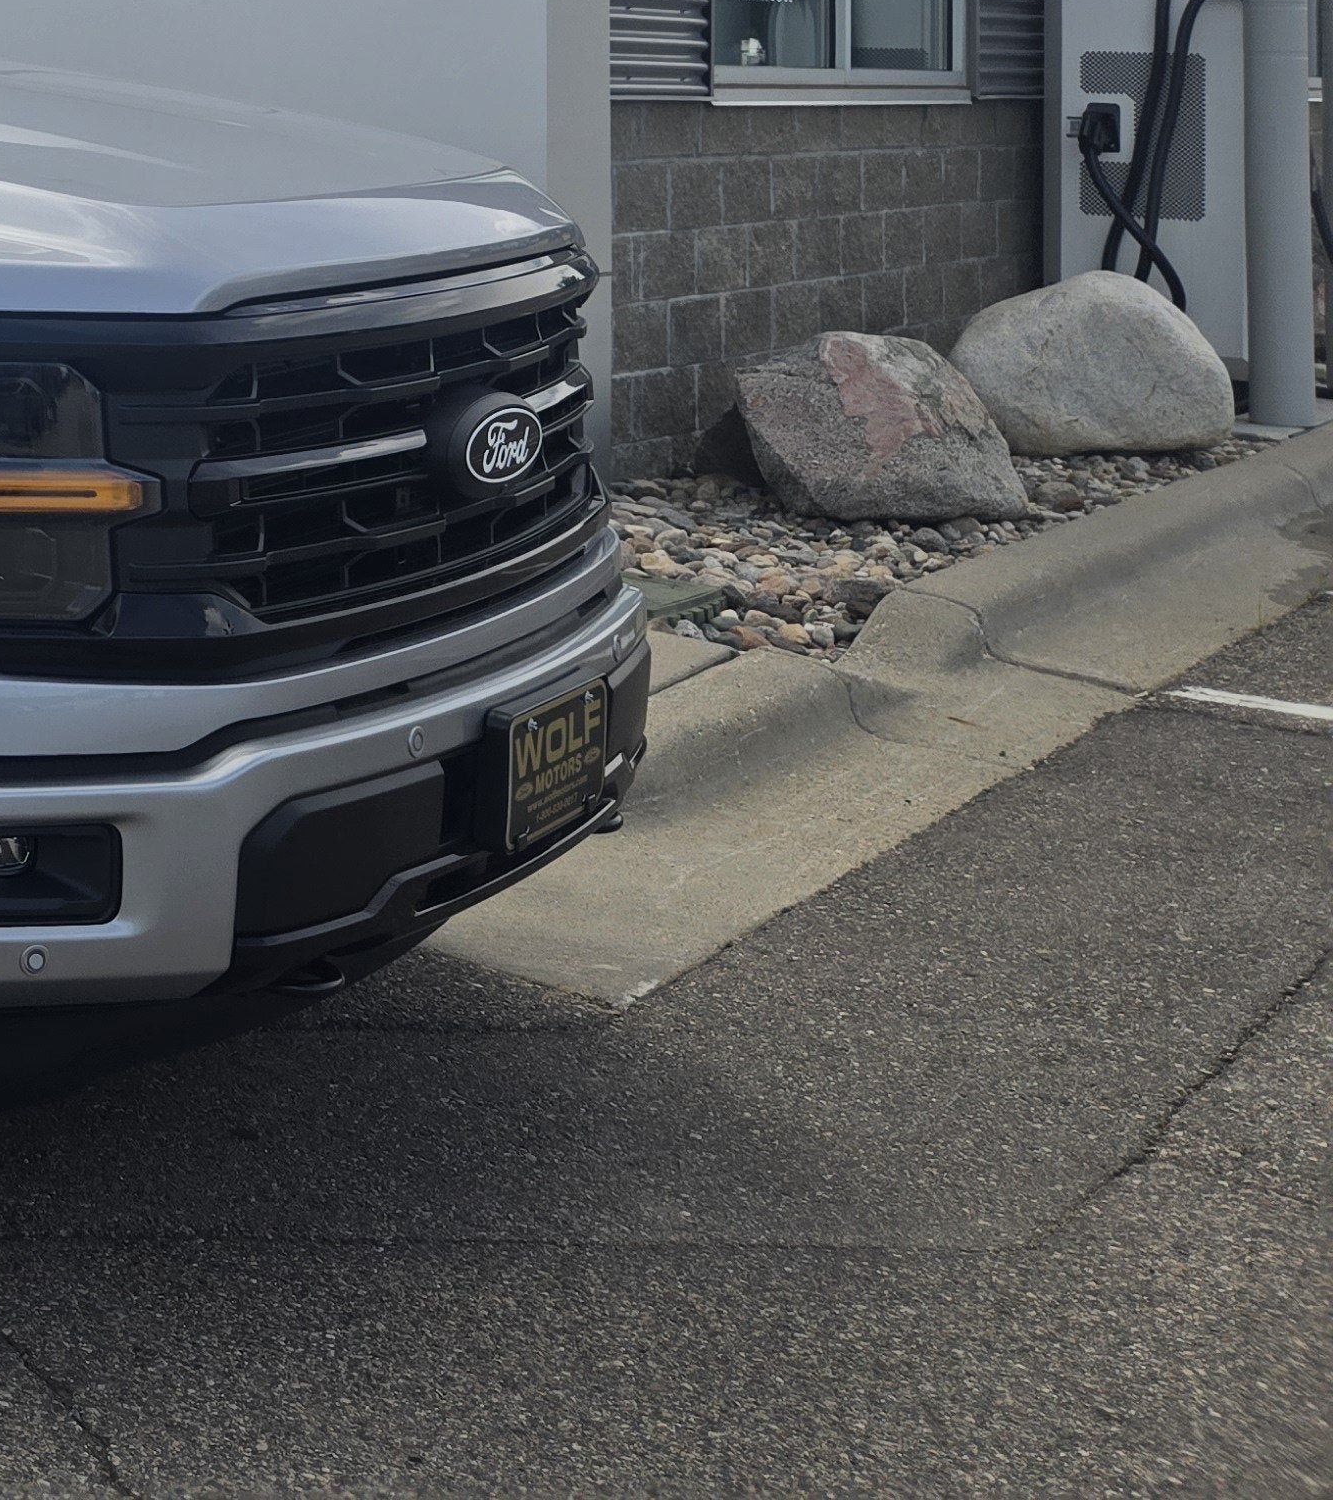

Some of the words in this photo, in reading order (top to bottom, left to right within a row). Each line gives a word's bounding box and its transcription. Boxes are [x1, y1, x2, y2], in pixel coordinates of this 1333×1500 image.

[482, 418, 530, 474] Ford
[515, 698, 602, 780] WOLF
[535, 752, 582, 795] MOTORS
